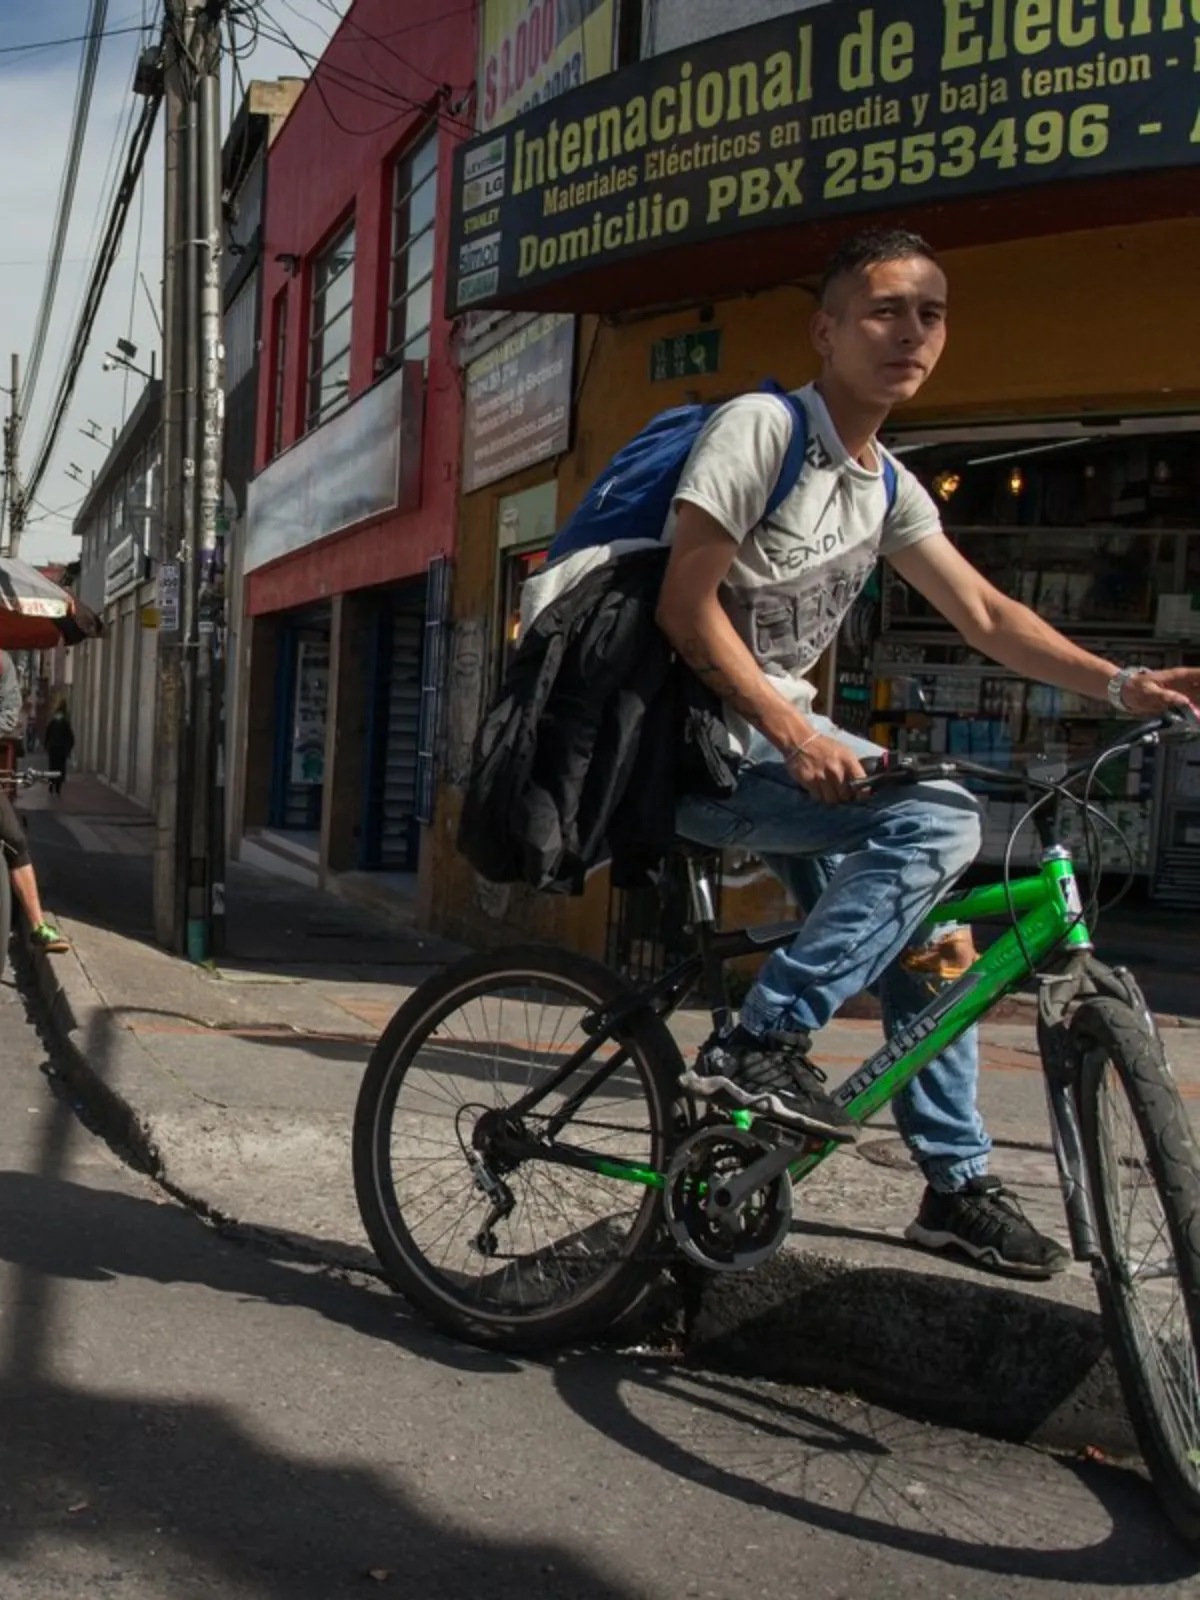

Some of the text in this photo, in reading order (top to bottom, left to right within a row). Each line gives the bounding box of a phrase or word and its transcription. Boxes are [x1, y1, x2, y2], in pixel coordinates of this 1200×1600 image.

[485, 176, 503, 196] LG
[512, 24, 813, 195] Internacional
[839, 9, 914, 92] de
[543, 164, 638, 217] Materiales
[644, 130, 761, 182] Eléctricos
[770, 121, 800, 149] en
[810, 94, 901, 141] media
[911, 93, 929, 128] y
[940, 72, 1008, 116] baja
[1021, 51, 1151, 99] tension
[517, 193, 690, 278] Domicilio
[706, 158, 805, 224] PBX
[823, 104, 1110, 199] 2553496
